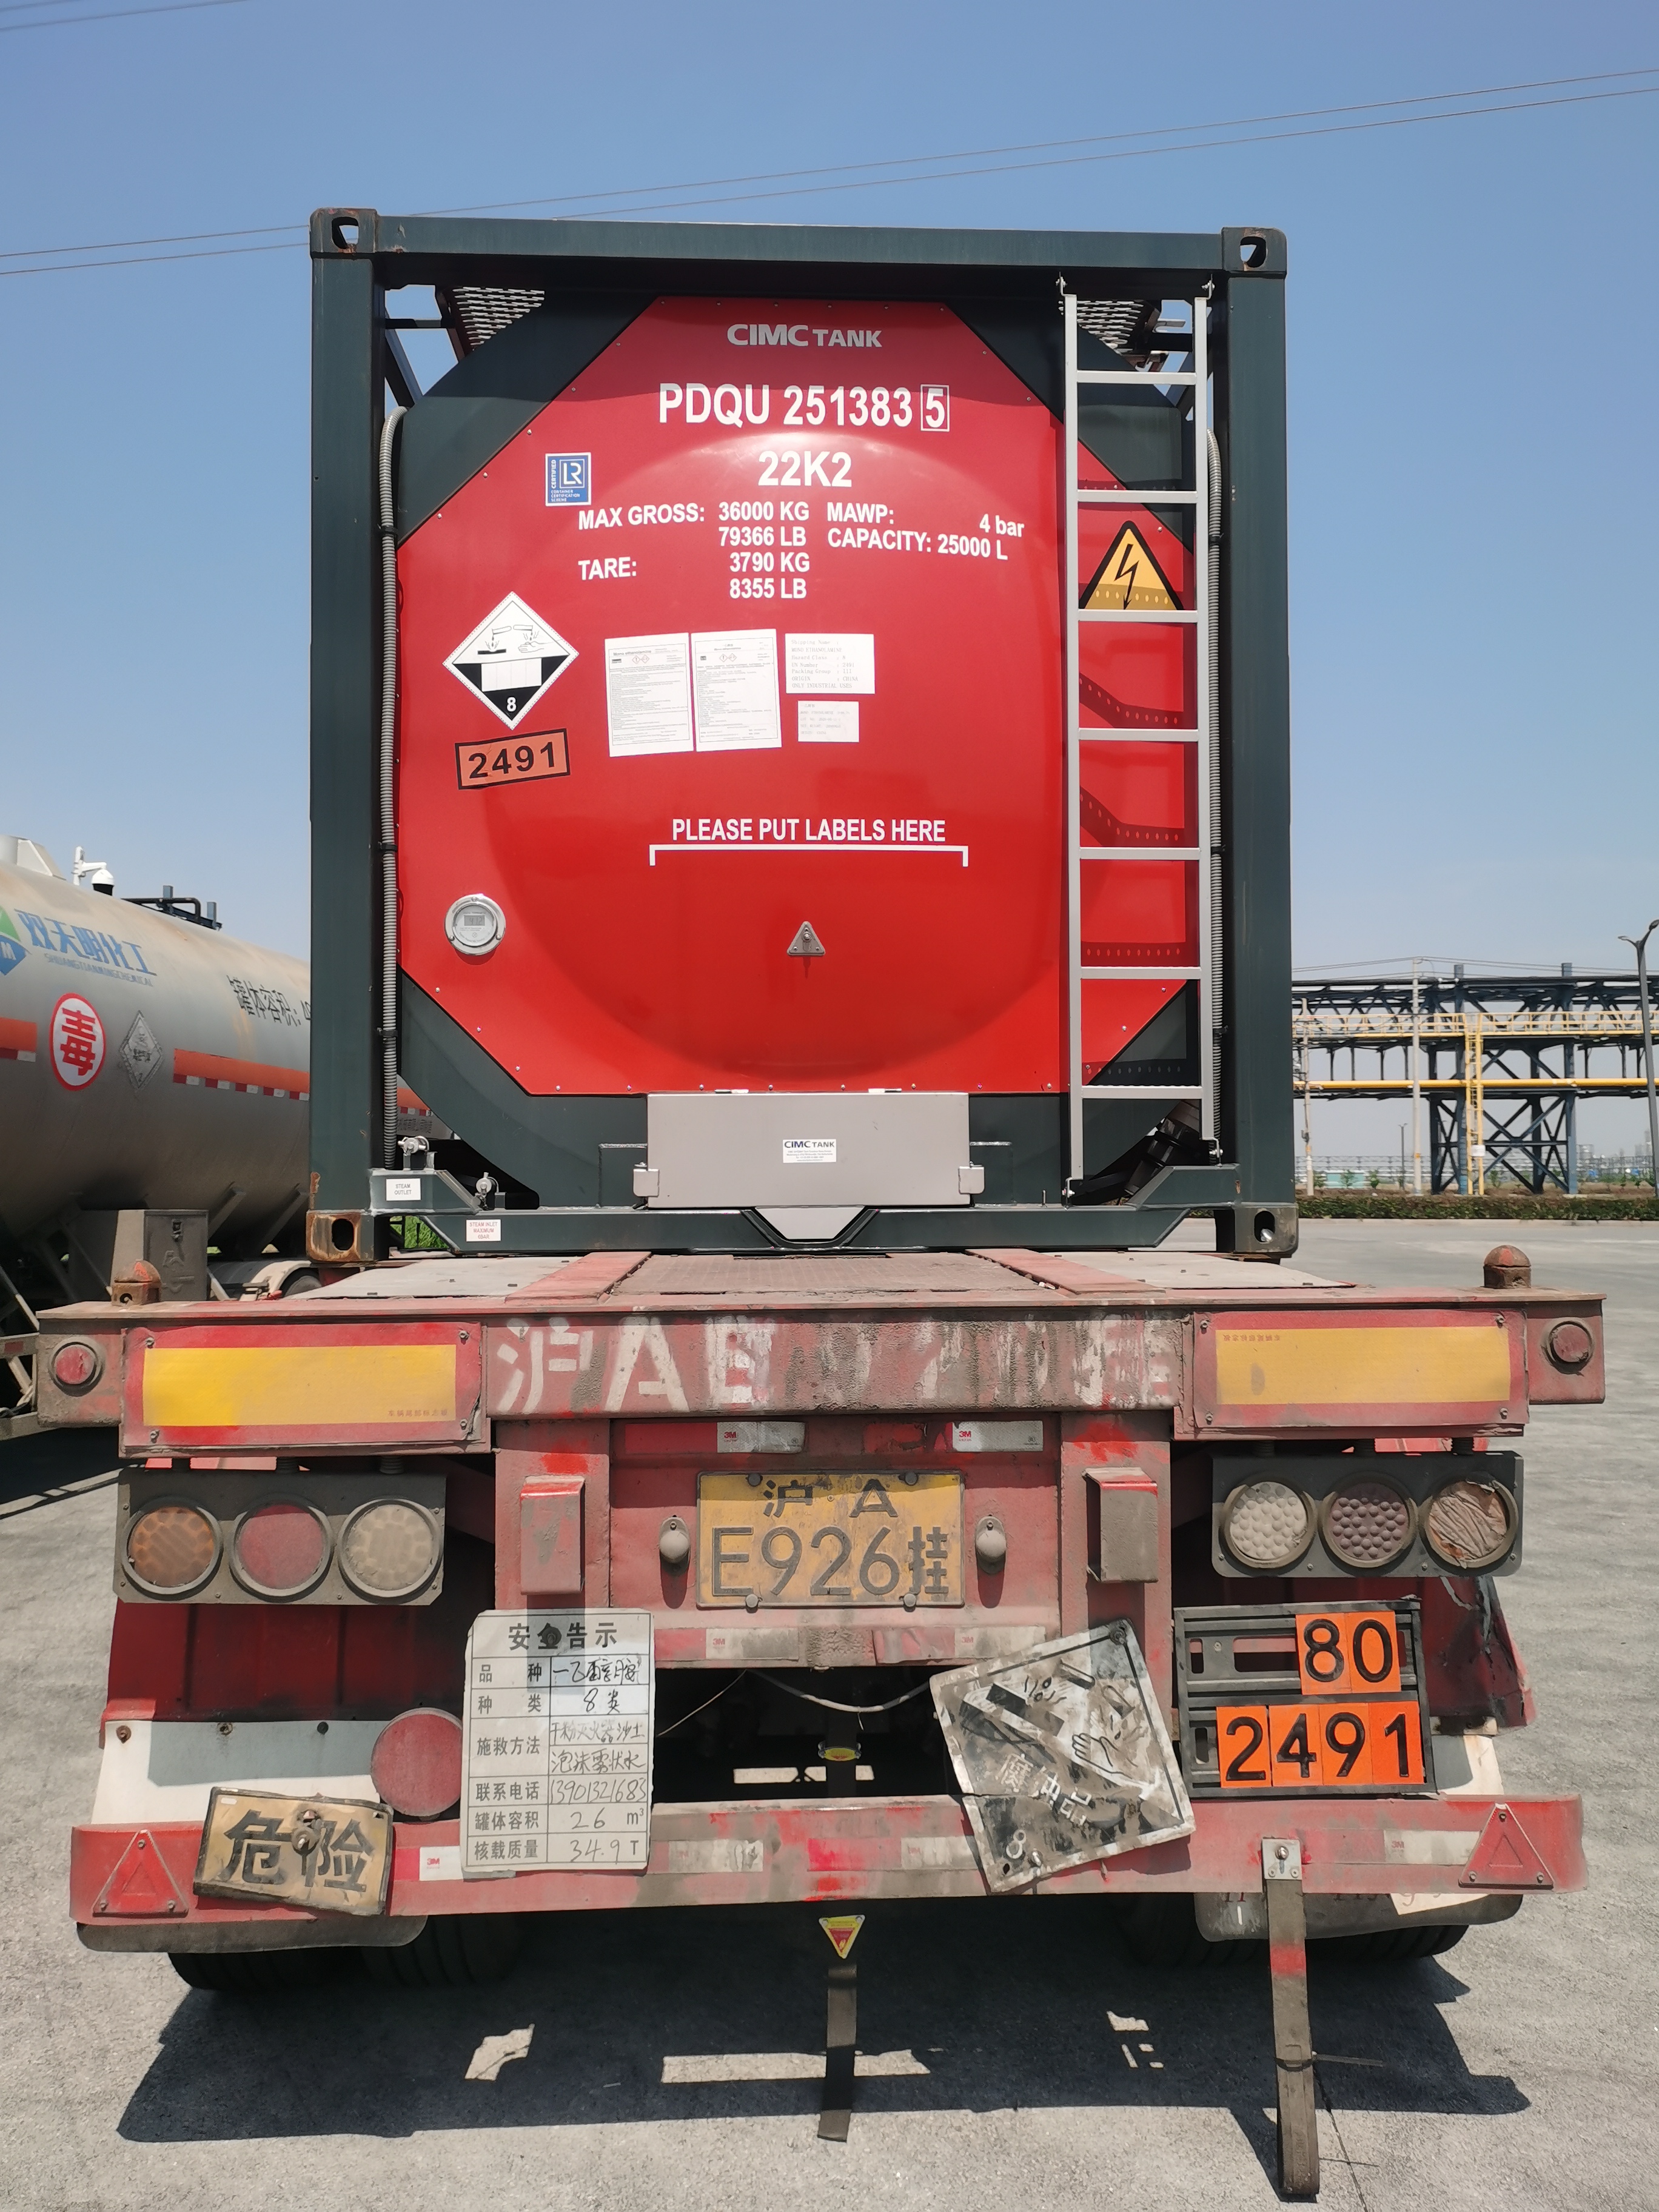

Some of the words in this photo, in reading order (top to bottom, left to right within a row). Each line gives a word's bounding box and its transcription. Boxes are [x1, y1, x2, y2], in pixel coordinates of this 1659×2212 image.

[727, 324, 808, 346] CIMC
[813, 329, 882, 347] TANK
[660, 383, 769, 427] PDQU
[783, 385, 913, 427] 251383
[925, 389, 945, 428] 5
[758, 451, 852, 487] 22K2
[578, 508, 623, 530] MAX
[628, 504, 705, 526] GROSS:
[719, 501, 774, 521] 36000
[780, 501, 809, 521] KG
[827, 502, 894, 525] MAWP:
[979, 514, 991, 533] 4
[996, 515, 1024, 537] bar
[719, 526, 774, 546] 79366
[780, 526, 806, 546] LB
[828, 528, 931, 552] CAPACITY:
[937, 534, 990, 557] 25000
[996, 540, 1008, 560] L
[578, 557, 637, 580] TARE:
[729, 552, 774, 572] 3790
[780, 552, 809, 572] KG
[729, 578, 775, 599] 8355
[780, 578, 806, 598] LB
[507, 697, 517, 712] 8
[468, 742, 554, 779] 2491
[672, 818, 752, 840] PLEASE
[759, 819, 799, 840] PUT
[806, 819, 885, 841] LABELS
[892, 819, 945, 842] HERE
[59, 1008, 97, 1076] 毒
[712, 1526, 949, 1596] E926挂
[508, 1622, 617, 1651] 安全告示
[1304, 1618, 1393, 1683] 80
[477, 1736, 540, 1757] 施救方法
[1225, 1712, 1409, 1781] 2491
[475, 1781, 540, 1801] 联系电话
[475, 1811, 539, 1831] 罐体容积
[571, 1807, 606, 1829] 26
[217, 1809, 374, 1892] 危险
[474, 1839, 538, 1860] 核载质量
[631, 1840, 638, 1855] T
[1005, 1829, 1027, 1859] 8
